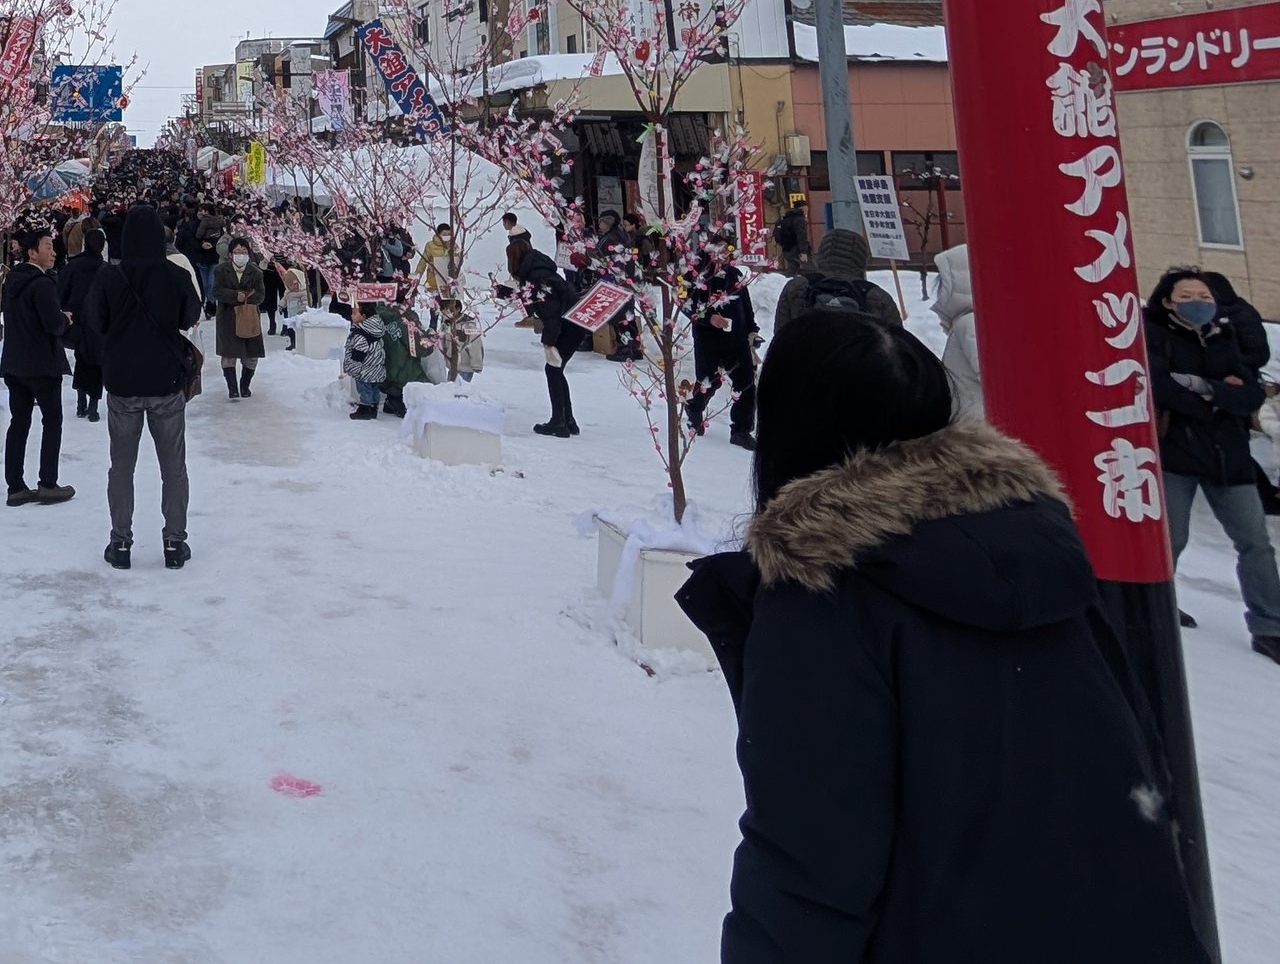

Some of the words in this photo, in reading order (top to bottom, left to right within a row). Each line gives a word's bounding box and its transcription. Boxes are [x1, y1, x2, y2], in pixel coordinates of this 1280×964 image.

[1108, 27, 1280, 76] ンランドリー
